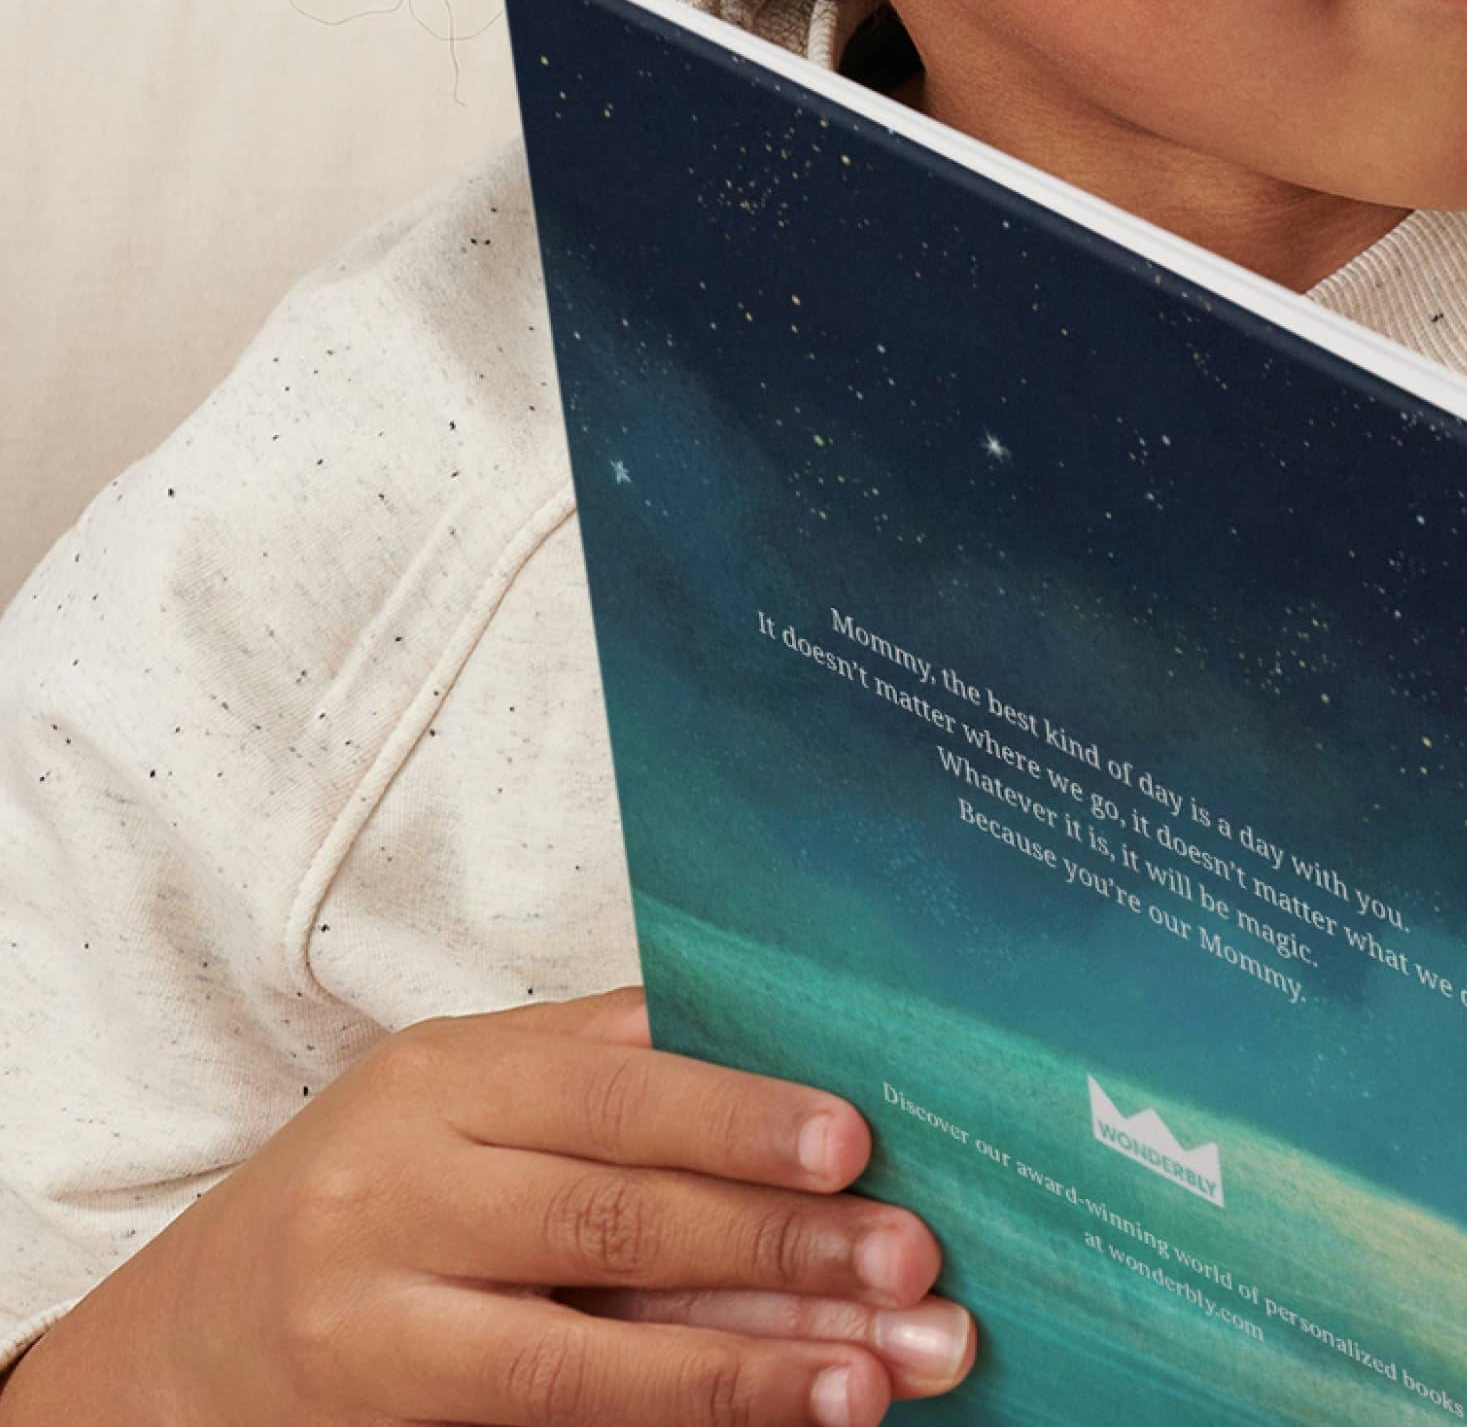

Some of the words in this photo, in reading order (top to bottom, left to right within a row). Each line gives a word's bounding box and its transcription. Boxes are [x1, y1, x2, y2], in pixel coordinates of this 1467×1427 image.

[758, 610, 776, 640] It
[781, 625, 869, 689] doesn’t
[874, 677, 957, 734] matter
[960, 722, 1042, 780] where
[1046, 767, 1083, 802] we
[1090, 792, 1126, 828] go,
[1131, 808, 1150, 838] it
[1156, 824, 1248, 890] doesn’t
[1252, 877, 1338, 936] matter
[1343, 926, 1409, 976] what
[1414, 962, 1453, 998] we
[830, 607, 937, 685] Mommy,
[941, 668, 981, 706] the
[986, 688, 1038, 737] best
[1043, 718, 1101, 770] kind
[1107, 760, 1133, 786] of
[1138, 772, 1183, 817] day
[1190, 796, 1211, 828] is
[1217, 817, 1232, 840] a
[1239, 825, 1285, 870] day
[1291, 855, 1349, 902] with
[1355, 889, 1410, 933] you.
[936, 745, 1058, 828] Whatever
[1065, 812, 1082, 842] it
[1088, 825, 1116, 862] is,
[1121, 842, 1140, 873] it
[1145, 860, 1193, 902] will
[1198, 882, 1229, 920] be
[1236, 909, 1318, 968] magic.
[958, 797, 1057, 868] Because
[1062, 857, 1141, 914] you’re
[1148, 905, 1192, 940] our
[1198, 925, 1306, 1004] Mommy.
[882, 1081, 970, 1145] Discover
[974, 1138, 1012, 1168] our
[1015, 1161, 1170, 1260] award-winning
[1173, 1246, 1233, 1292] world
[1237, 1283, 1259, 1305] of
[1264, 1297, 1398, 1381] personalized
[1401, 1368, 1465, 1419] books
[1096, 1120, 1217, 1198] WONDERBLY
[1084, 1231, 1103, 1253] at
[1108, 1243, 1264, 1342] wonderbly.com
